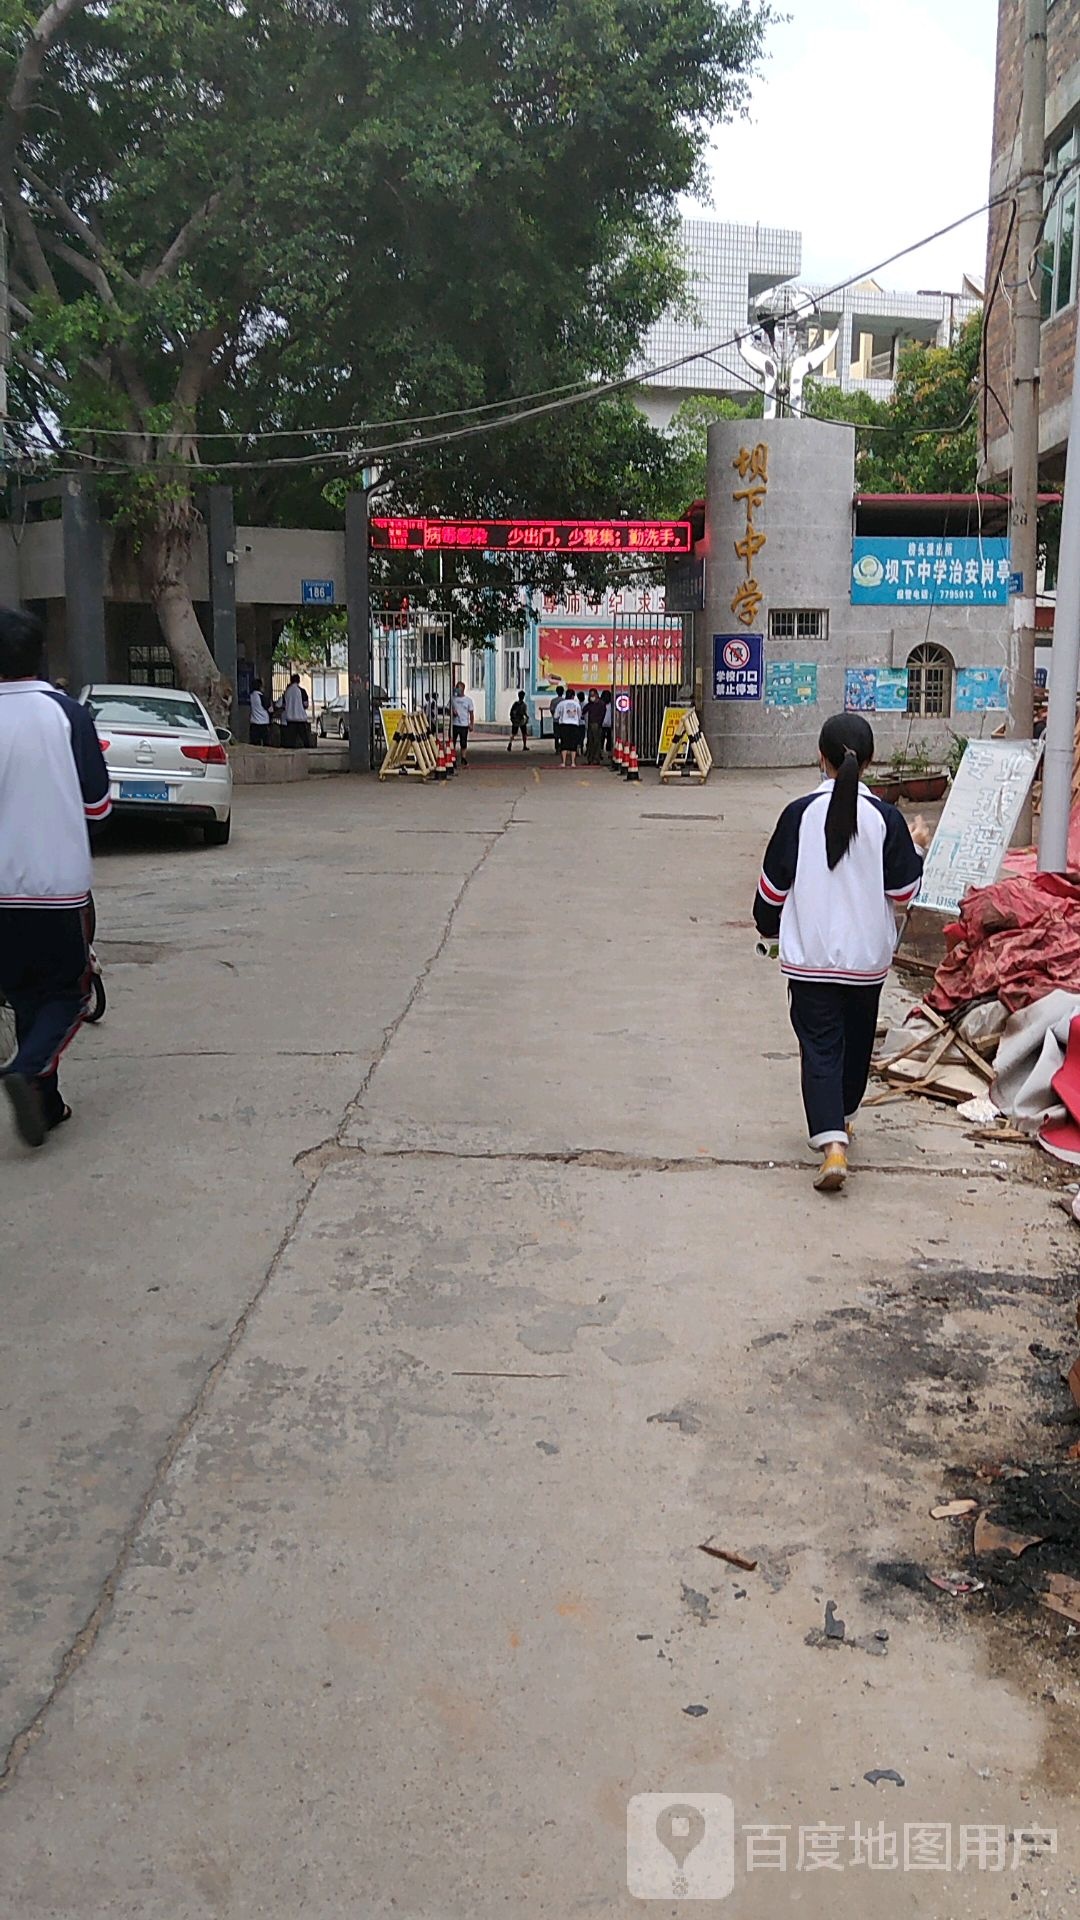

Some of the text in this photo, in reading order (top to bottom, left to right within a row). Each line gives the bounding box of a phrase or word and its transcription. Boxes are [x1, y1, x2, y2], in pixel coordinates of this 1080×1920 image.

[732, 443, 768, 626] 坝下中学
[885, 558, 1011, 586] 坝下中学治安岗亭
[308, 586, 326, 599] 186
[982, 589, 998, 599] 110
[716, 670, 758, 682] 学校门口
[716, 683, 758, 695] 禁止停车
